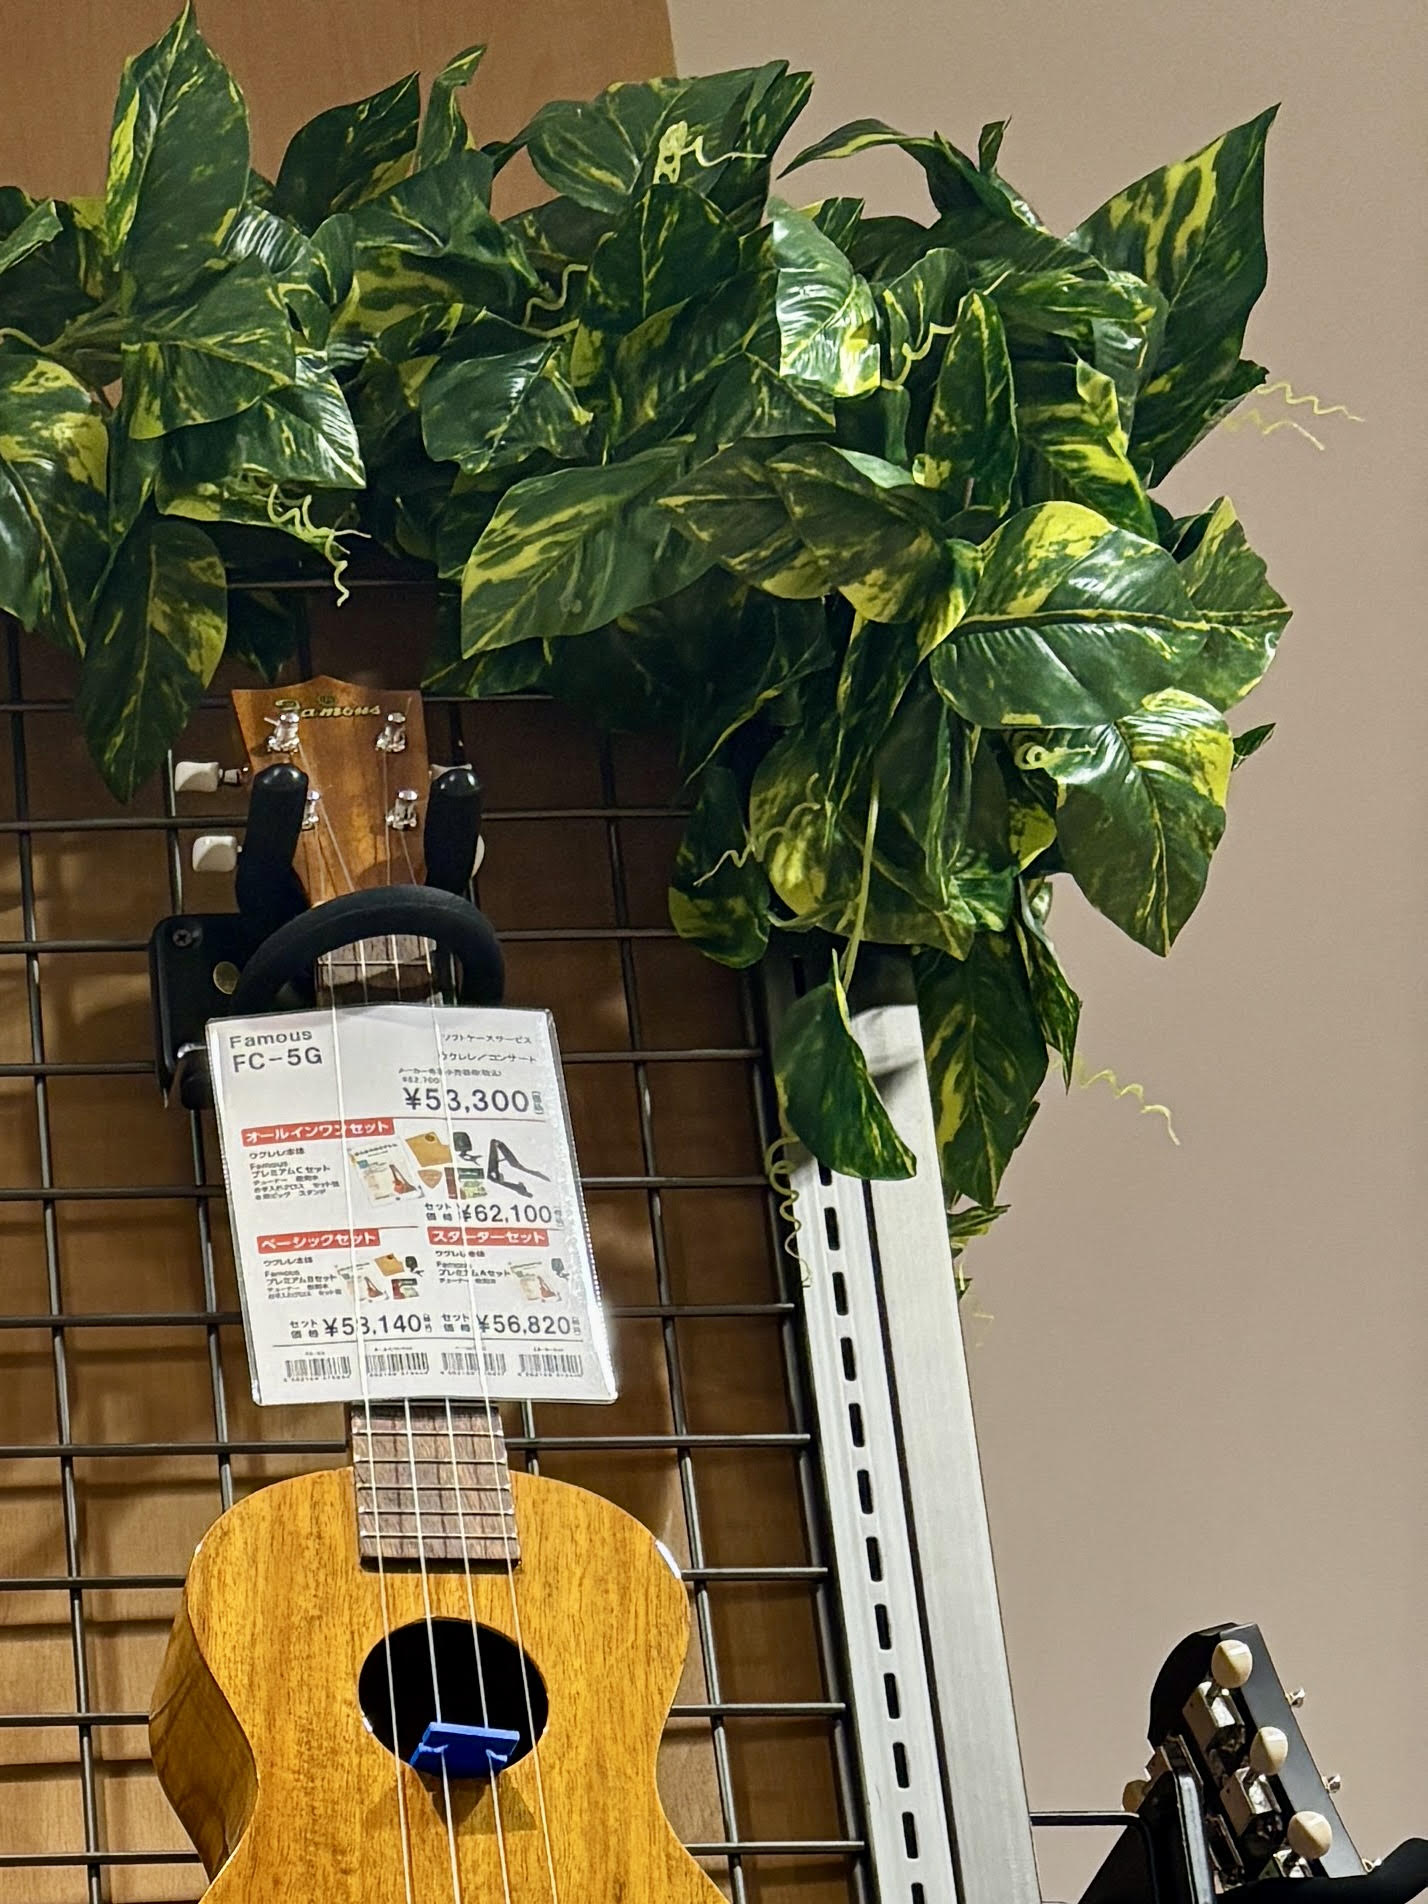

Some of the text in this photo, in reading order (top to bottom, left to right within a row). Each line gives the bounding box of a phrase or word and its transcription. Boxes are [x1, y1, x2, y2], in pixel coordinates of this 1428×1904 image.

[228, 1030, 313, 1048] Famous
[231, 1047, 324, 1072] FC-5G
[402, 1084, 531, 1115] ¥53,300
[458, 1203, 553, 1225] ¥62,100
[477, 1313, 571, 1336] ¥56,820
